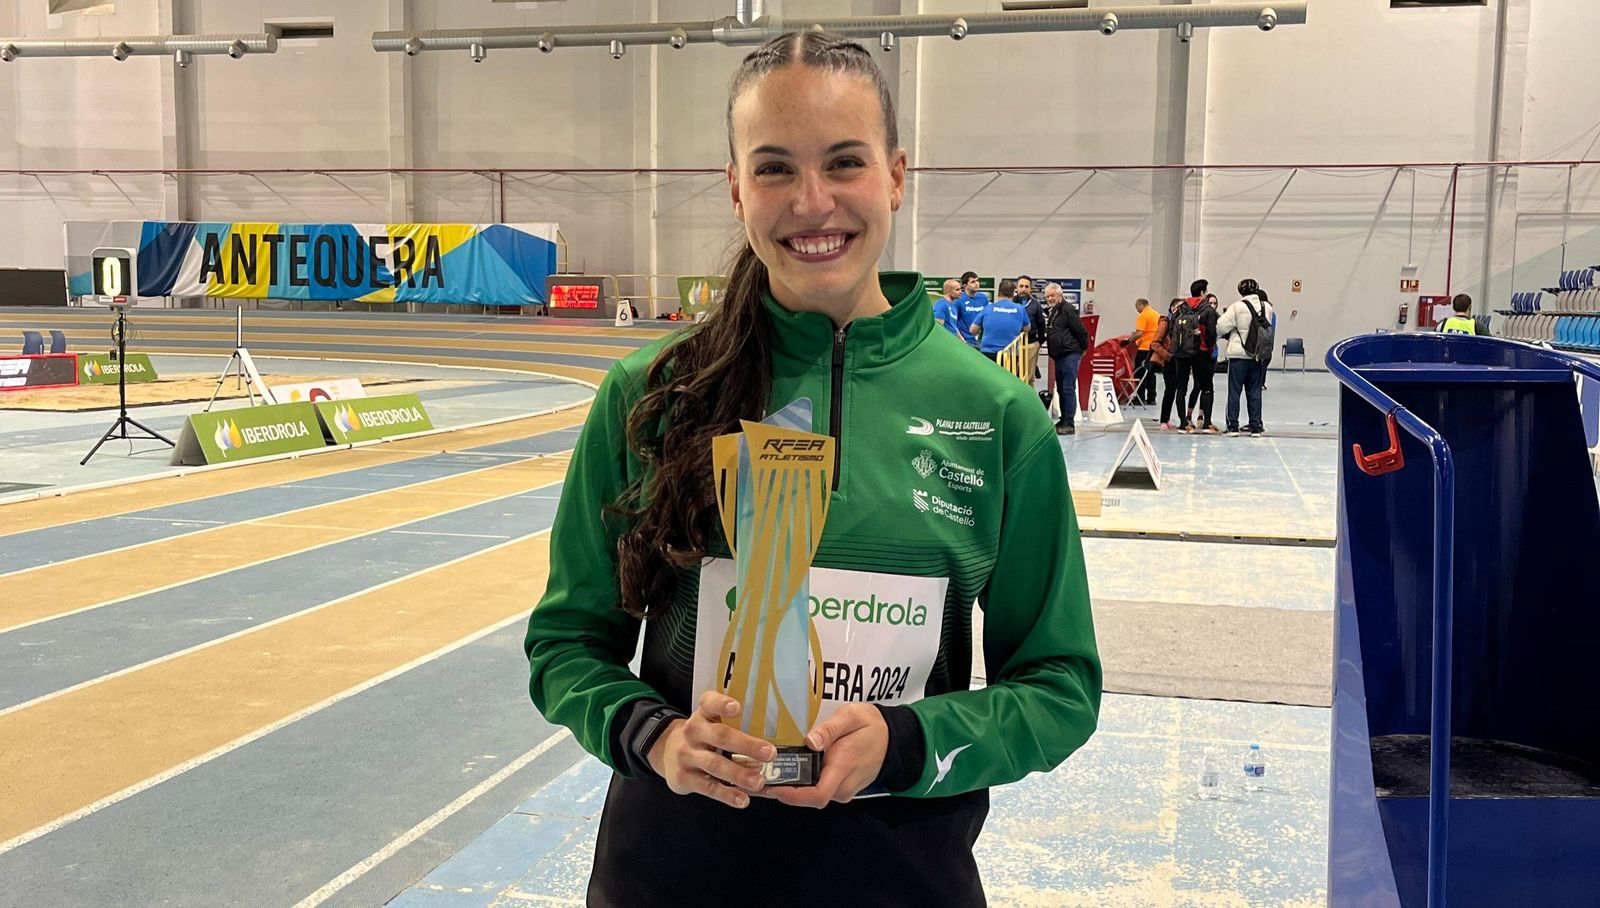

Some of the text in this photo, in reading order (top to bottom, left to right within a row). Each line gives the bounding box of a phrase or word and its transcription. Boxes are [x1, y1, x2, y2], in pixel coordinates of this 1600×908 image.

[199, 232, 444, 289] ANTEQUERA
[102, 256, 121, 297] 0
[619, 308, 628, 321] 6
[101, 363, 146, 375] IBERROLA
[1090, 391, 1098, 413] 3
[1106, 391, 1117, 414] 3
[358, 406, 424, 428] IBERDROLA
[954, 421, 963, 429] DE
[241, 421, 310, 445] IBERDROLA
[762, 438, 827, 453] RFEA
[759, 453, 825, 462] ATLETISMO
[940, 459, 985, 476] Ajuntament de
[939, 467, 984, 487] Castelló
[947, 481, 972, 493] Esports
[931, 495, 973, 516] Diputació
[932, 506, 975, 527] de Castelló
[867, 665, 911, 703] 2024
